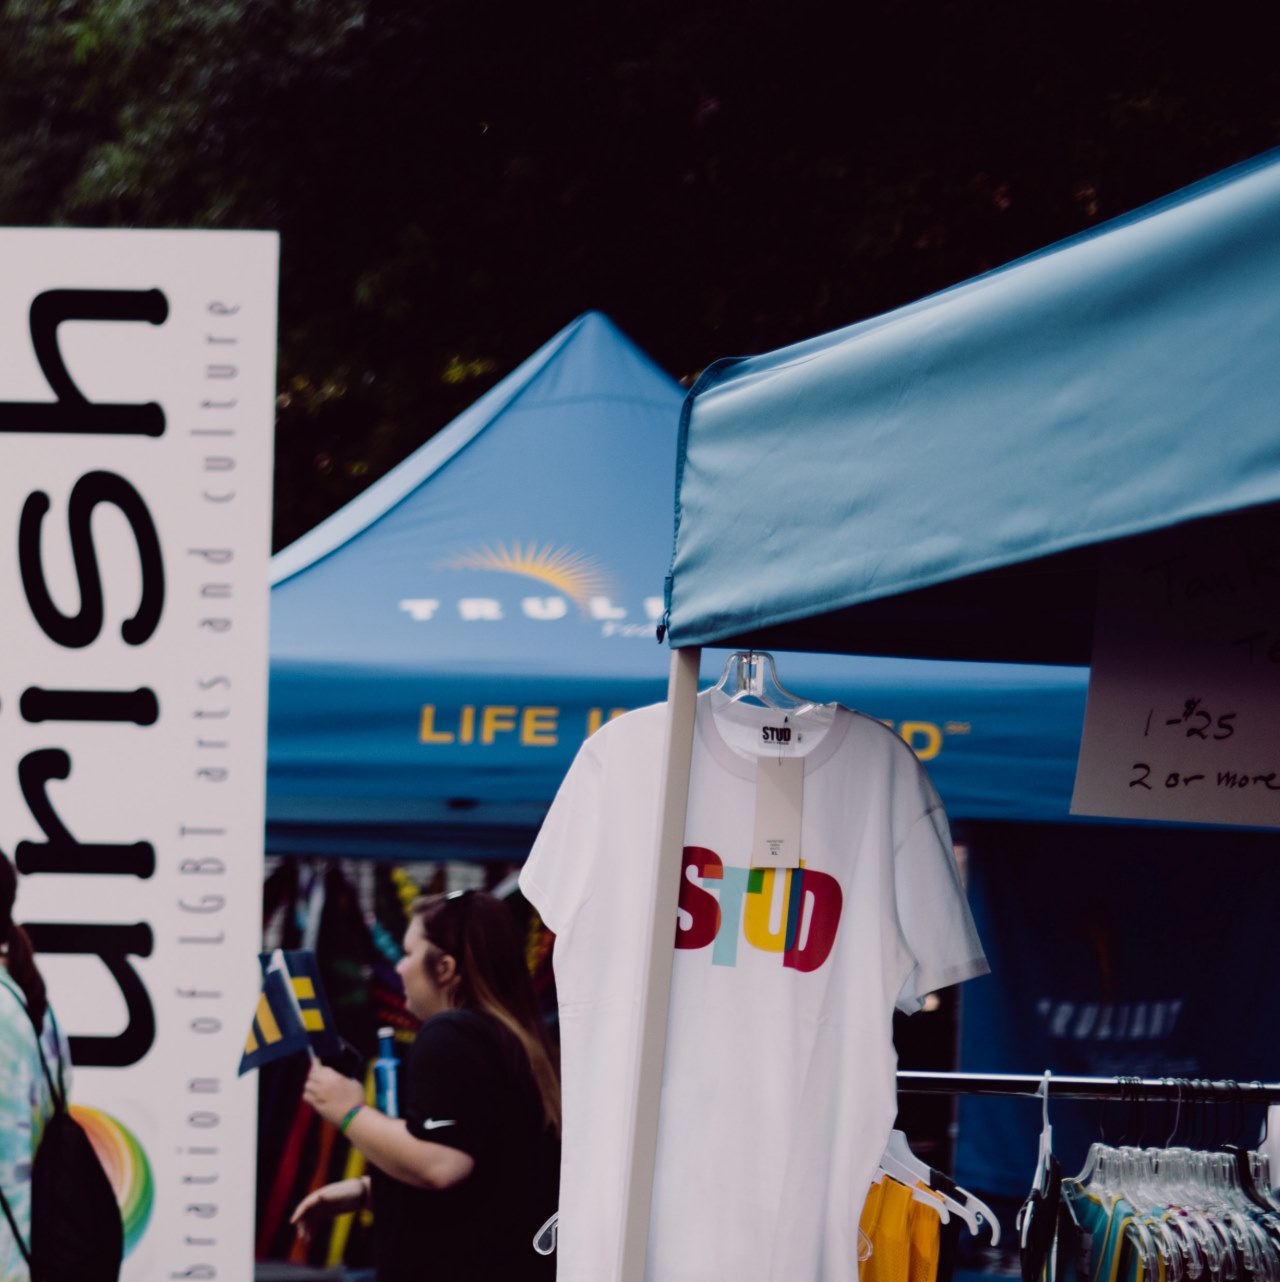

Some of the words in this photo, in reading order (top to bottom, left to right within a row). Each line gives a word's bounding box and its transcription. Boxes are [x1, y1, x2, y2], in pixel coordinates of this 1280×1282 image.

[189, 301, 241, 504] culture
[187, 548, 234, 632] and
[191, 674, 231, 784] arts
[419, 704, 559, 747] LIFE
[762, 726, 792, 742] STUD
[1129, 762, 1153, 790] 2
[1164, 772, 1206, 789] or
[177, 823, 227, 947] LGBT
[675, 845, 843, 973] STUD
[173, 987, 223, 1036] of
